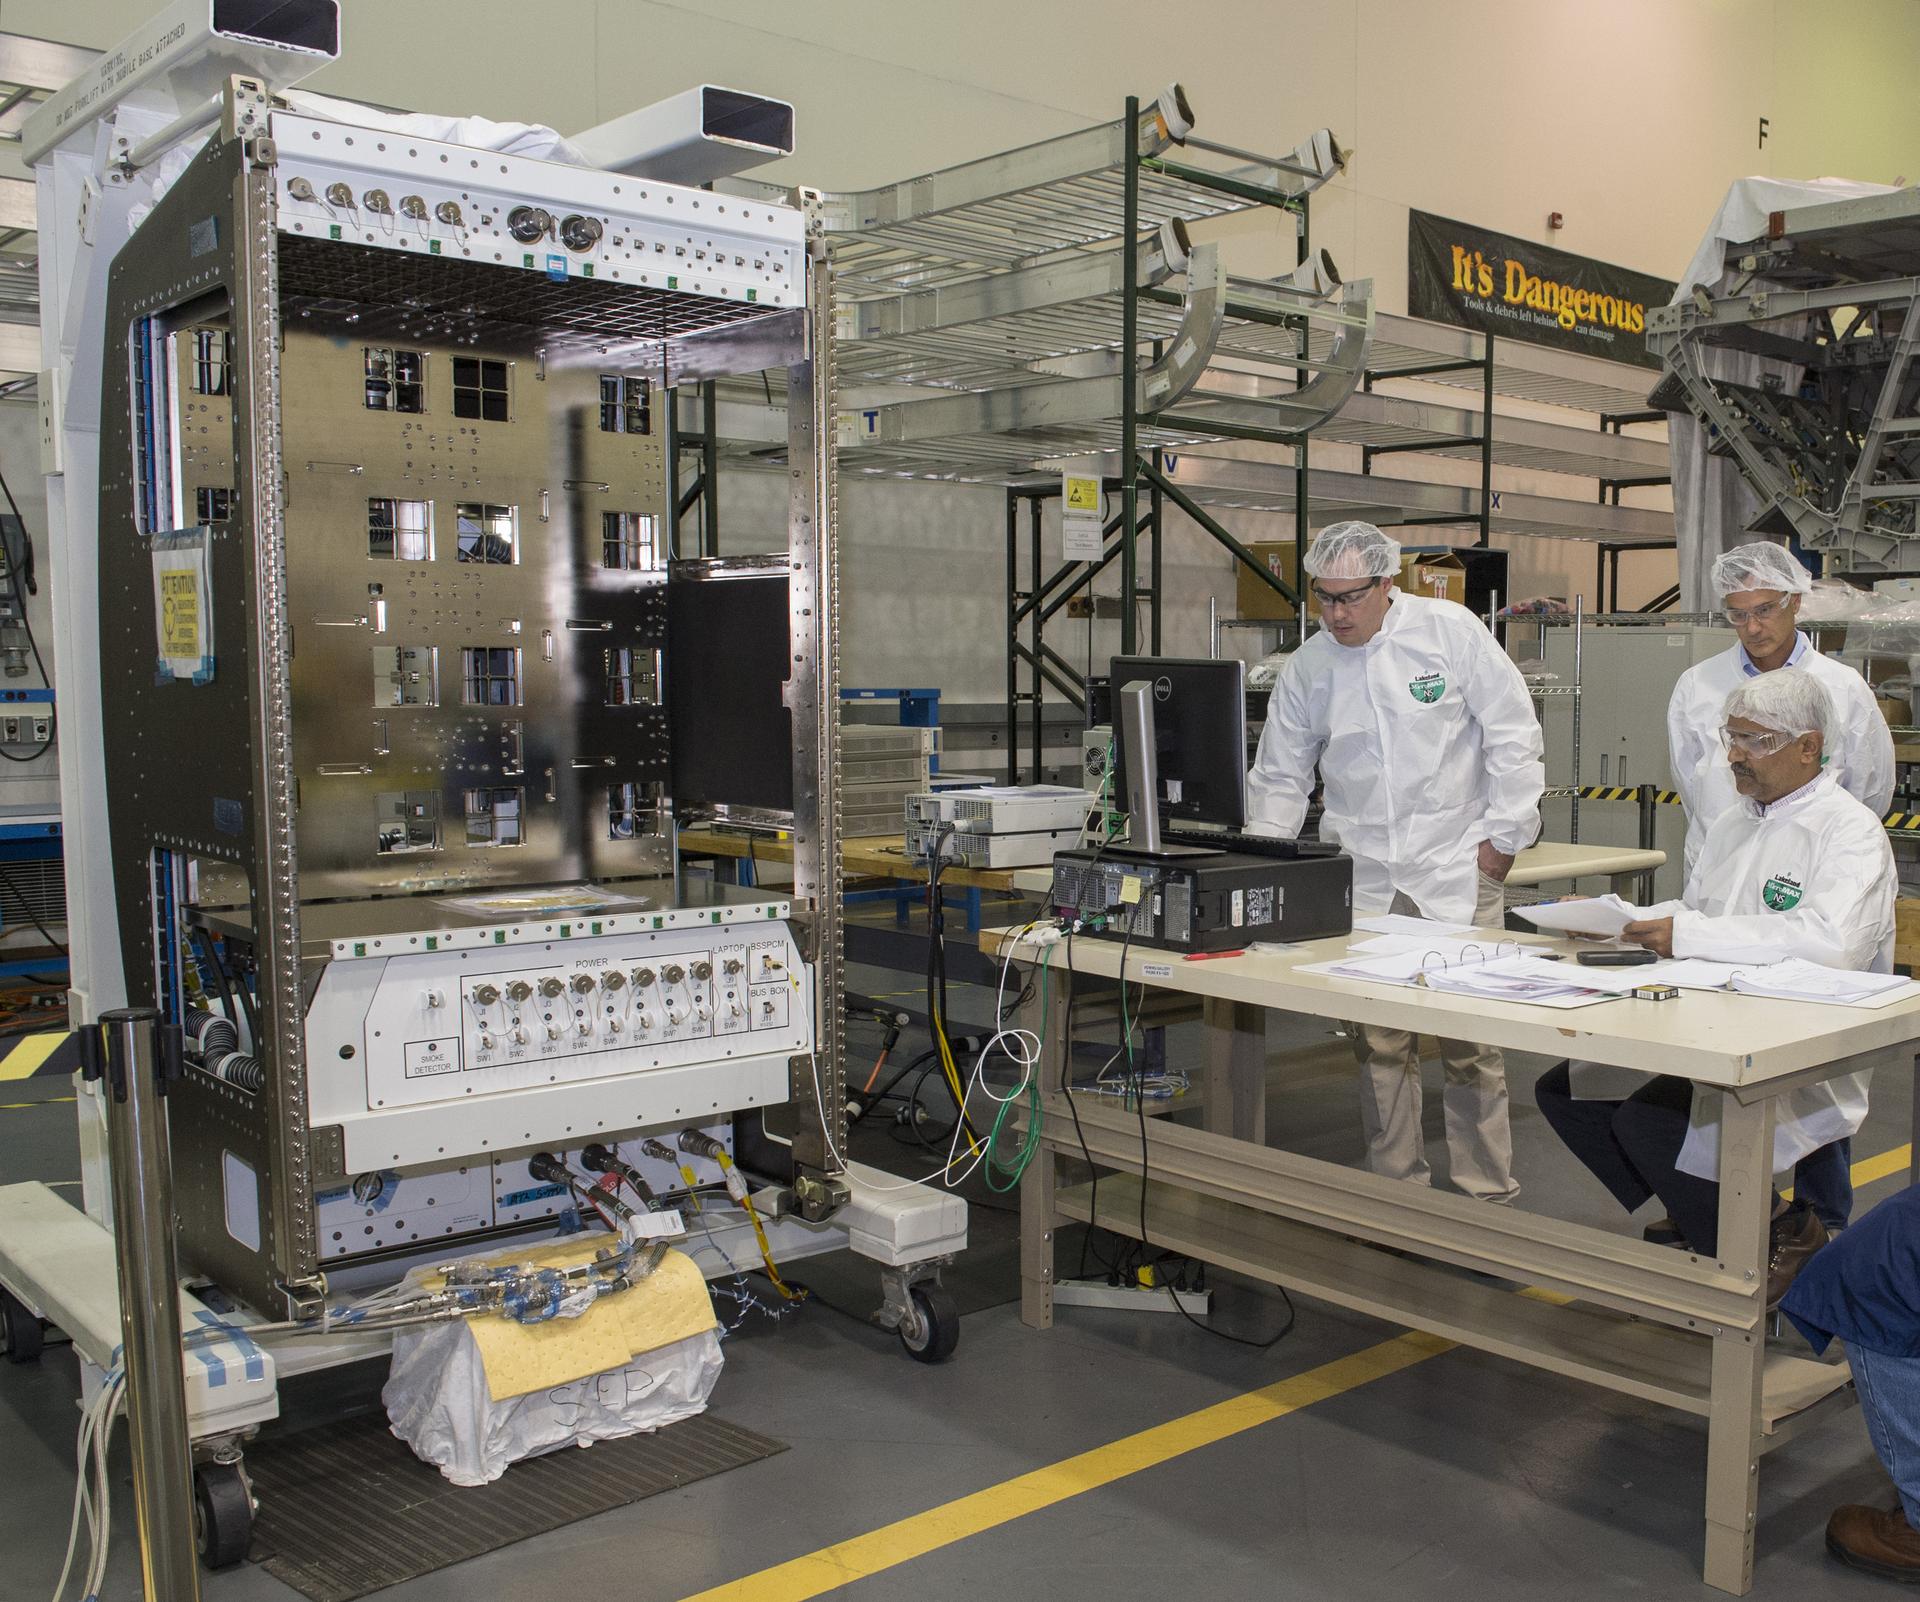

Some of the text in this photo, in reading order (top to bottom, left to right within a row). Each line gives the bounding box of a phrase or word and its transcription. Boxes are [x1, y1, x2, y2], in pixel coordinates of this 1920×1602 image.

[56, 22, 185, 127] DO NOT FORKLIFT WITH MOBILE BASE ATTACHED
[1759, 117, 1769, 150] F
[1451, 245, 1645, 334] It's Dangerous
[1463, 296, 1615, 343] Tools & debris left behind can damage
[863, 411, 879, 433] T
[1164, 454, 1178, 473] V
[1491, 492, 1501, 509] X
[162, 575, 197, 595] ATTENTION
[1415, 673, 1440, 681] Lakeland
[1410, 680, 1444, 689] MicroMAX
[1423, 688, 1434, 697] NS
[1774, 874, 1801, 887] Lakeland
[1766, 881, 1801, 899] MicroMAX
[1773, 893, 1786, 903] NS
[713, 943, 745, 954] LAPTOP
[750, 940, 785, 951] BSSPCM
[575, 958, 609, 969] POWER
[751, 986, 787, 997] BUS BOX
[479, 1008, 486, 1016] J1
[664, 1029, 677, 1038] SW7
[572, 1041, 588, 1049] SW4
[603, 1037, 617, 1045] SW5
[421, 1053, 445, 1063] SMOKE
[509, 1050, 525, 1058] SW2
[415, 1063, 451, 1074] DETECTOR
